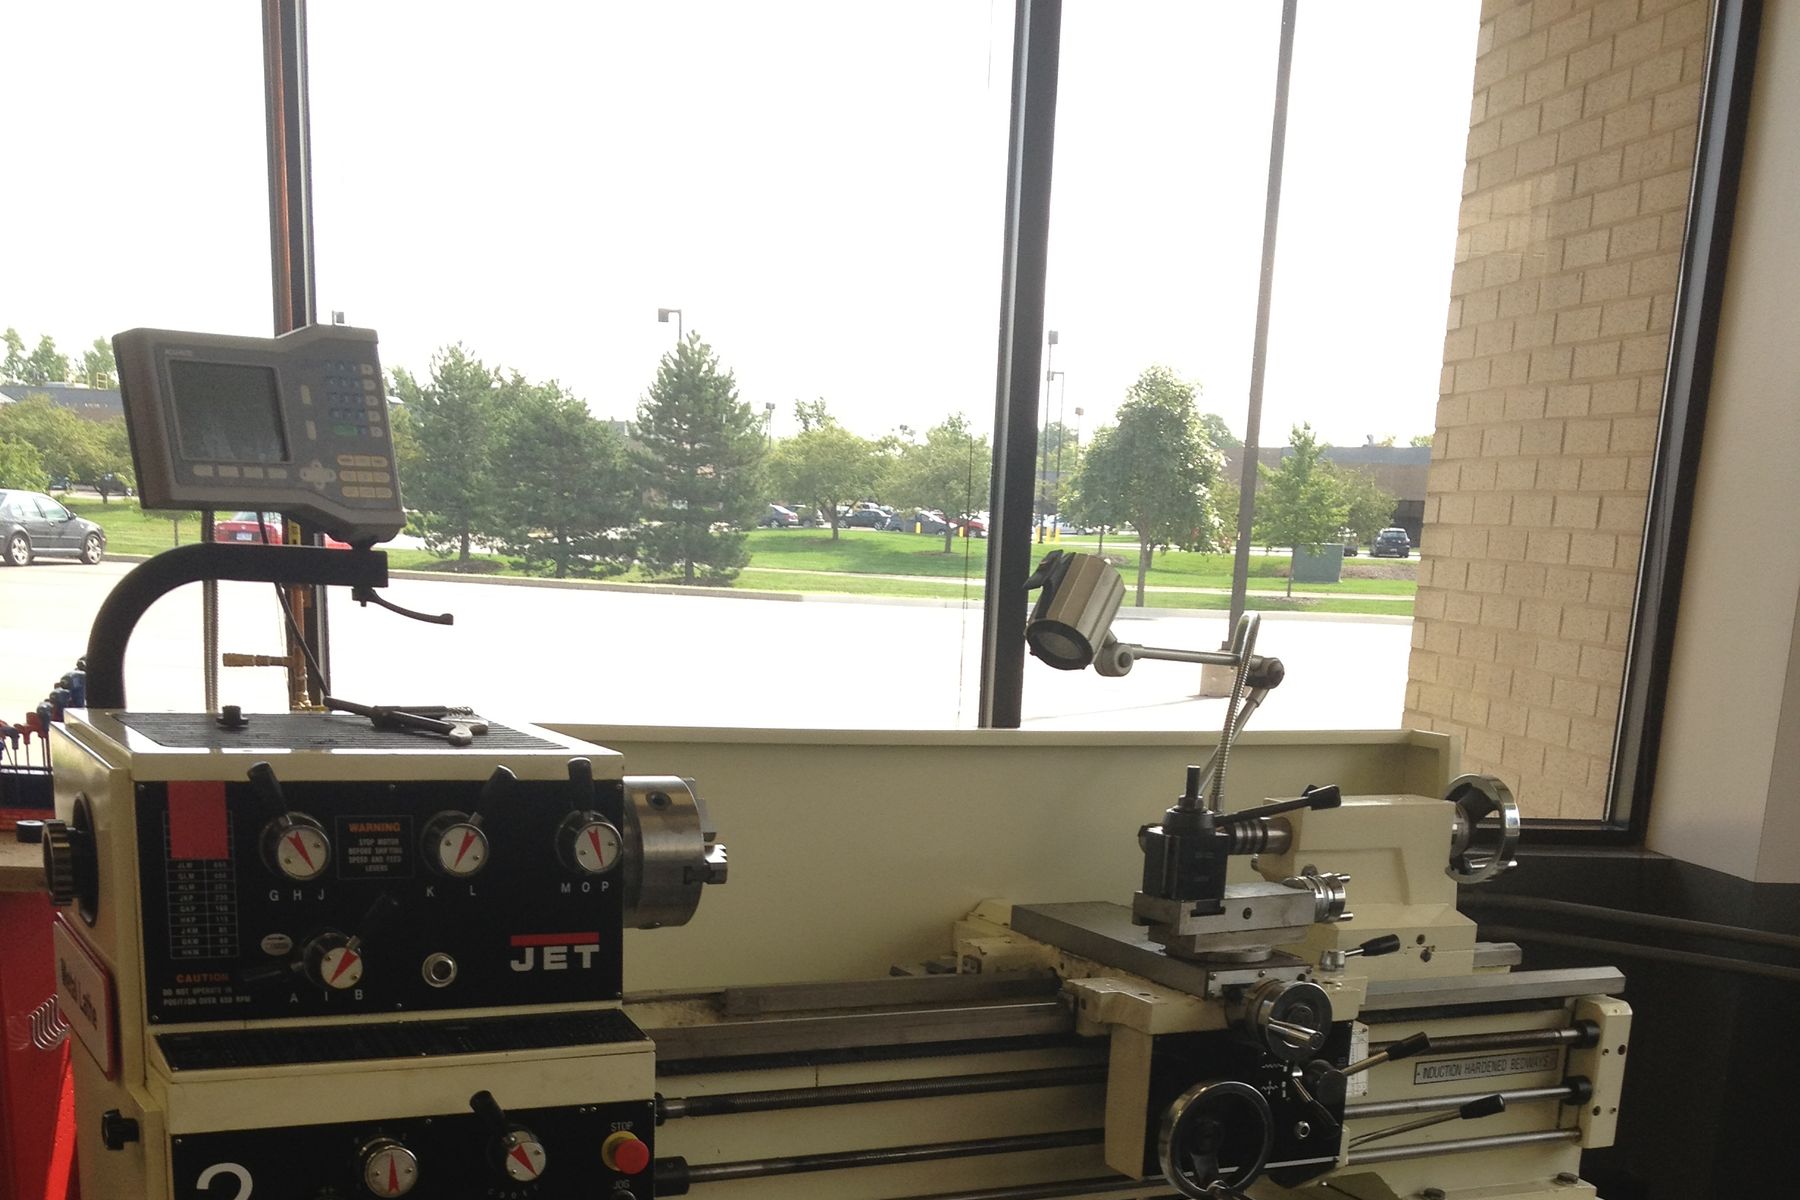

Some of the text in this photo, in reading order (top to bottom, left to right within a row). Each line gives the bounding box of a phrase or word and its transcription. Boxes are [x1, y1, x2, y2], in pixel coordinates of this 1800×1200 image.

[348, 822, 401, 832] WARNING
[426, 885, 476, 897] K L
[560, 881, 609, 893] M O P
[269, 888, 325, 901] G H J
[510, 944, 600, 972] JET
[176, 973, 229, 983] CAUTION
[163, 998, 196, 1006] POSITION
[290, 993, 298, 1003] A
[355, 989, 363, 1001] B
[1422, 1064, 1461, 1079] INDUCTION
[1464, 1058, 1507, 1074] HARDENED
[610, 1121, 634, 1132] STOP
[613, 1179, 630, 1189] JOG
